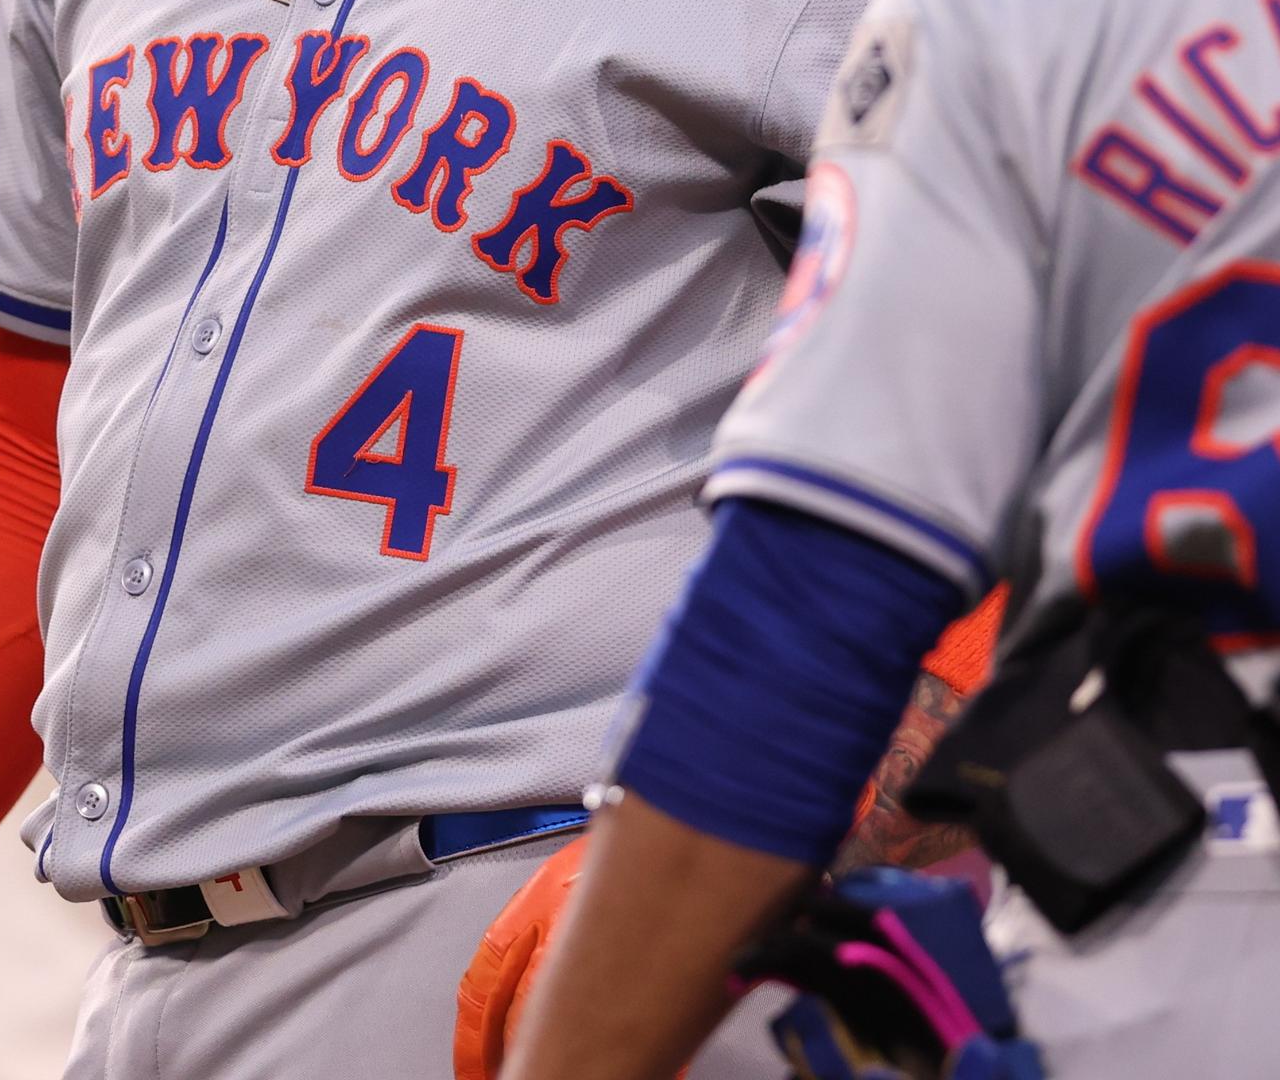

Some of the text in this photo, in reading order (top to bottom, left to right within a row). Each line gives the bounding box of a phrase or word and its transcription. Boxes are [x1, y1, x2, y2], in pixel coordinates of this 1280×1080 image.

[64, 32, 269, 226] EW
[270, 29, 634, 305] YORK
[305, 323, 466, 562] 4
